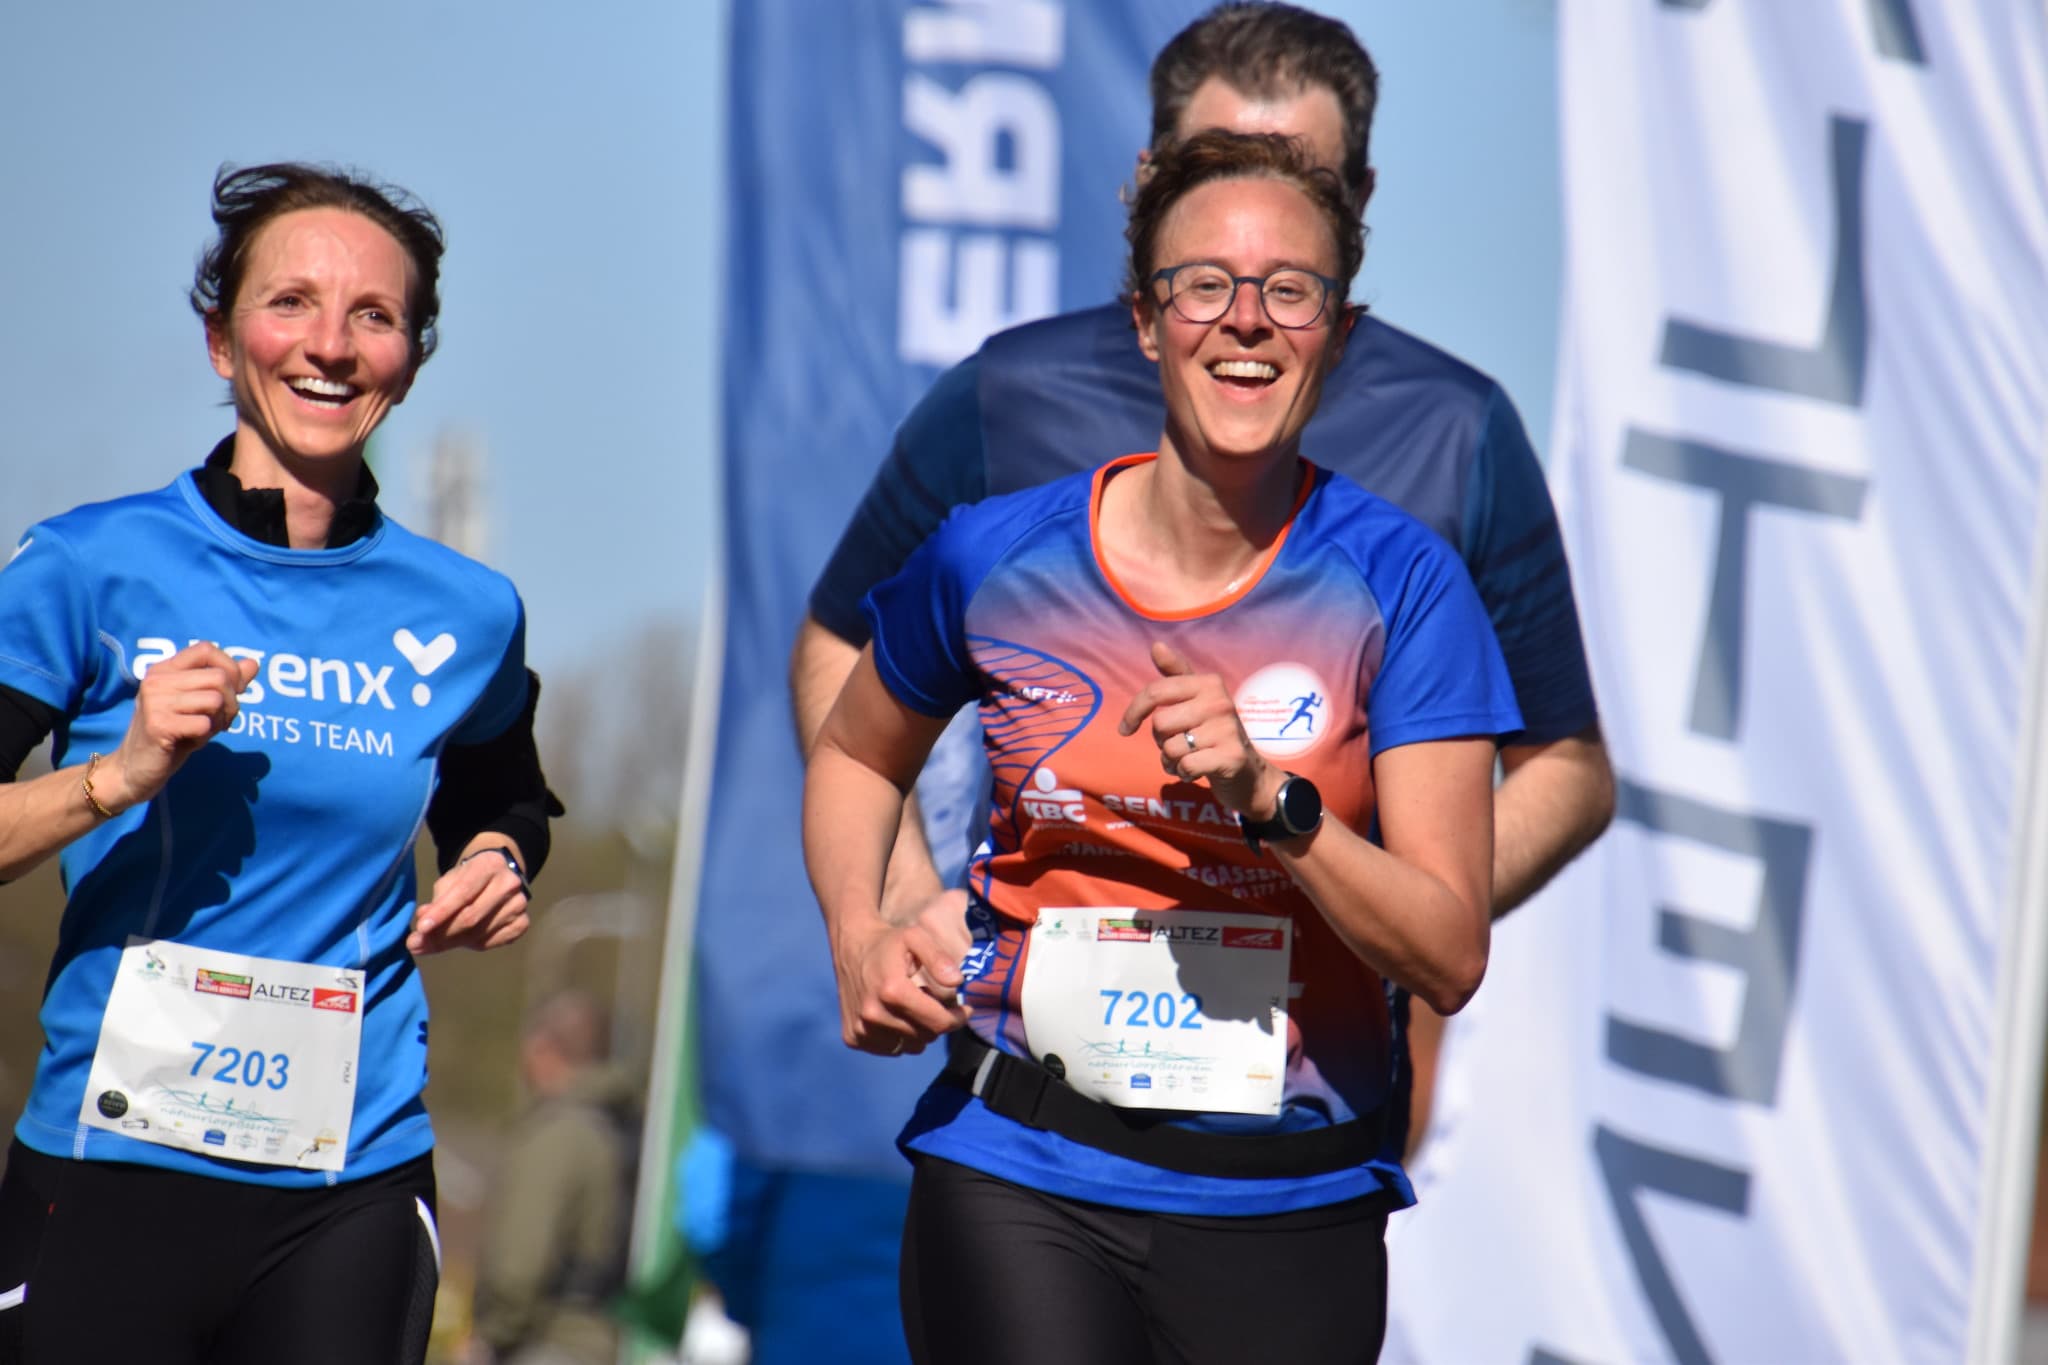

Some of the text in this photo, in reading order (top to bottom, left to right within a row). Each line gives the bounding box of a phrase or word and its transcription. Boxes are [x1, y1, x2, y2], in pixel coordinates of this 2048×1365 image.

[133, 637, 396, 711] agenx
[226, 712, 394, 758] ORTS TEAM
[1022, 801, 1087, 823] KBC
[1154, 925, 1220, 941] ALTEZ
[254, 983, 310, 1002] ALTEZ
[1100, 989, 1203, 1030] 7202
[190, 1041, 290, 1090] 7203
